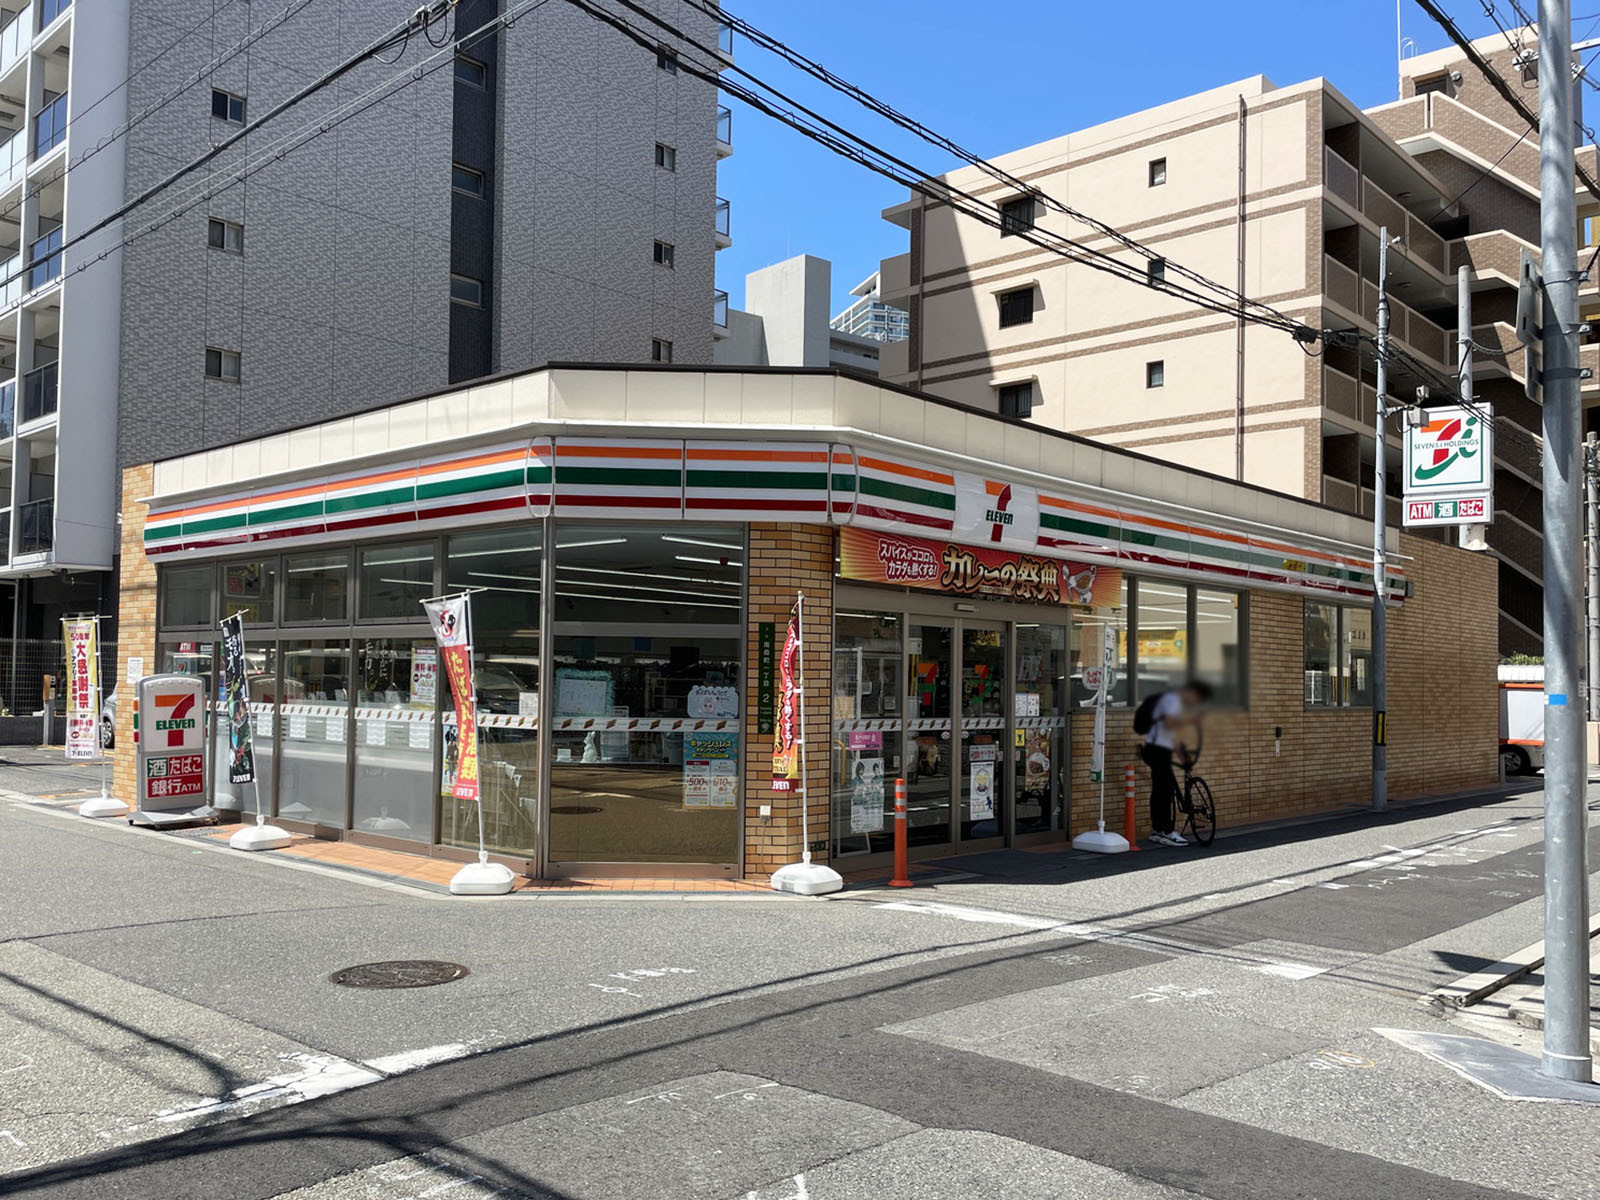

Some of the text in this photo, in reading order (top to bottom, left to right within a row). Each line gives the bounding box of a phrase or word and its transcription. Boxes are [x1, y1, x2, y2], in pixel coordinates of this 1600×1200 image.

[1444, 439, 1479, 448] HOLDINGS
[1411, 502, 1432, 519] ATM
[1459, 500, 1483, 517] たばこ
[942, 547, 1060, 601] カレーの祭典
[762, 693, 770, 703] 2
[149, 757, 202, 777] 酒 たばこ
